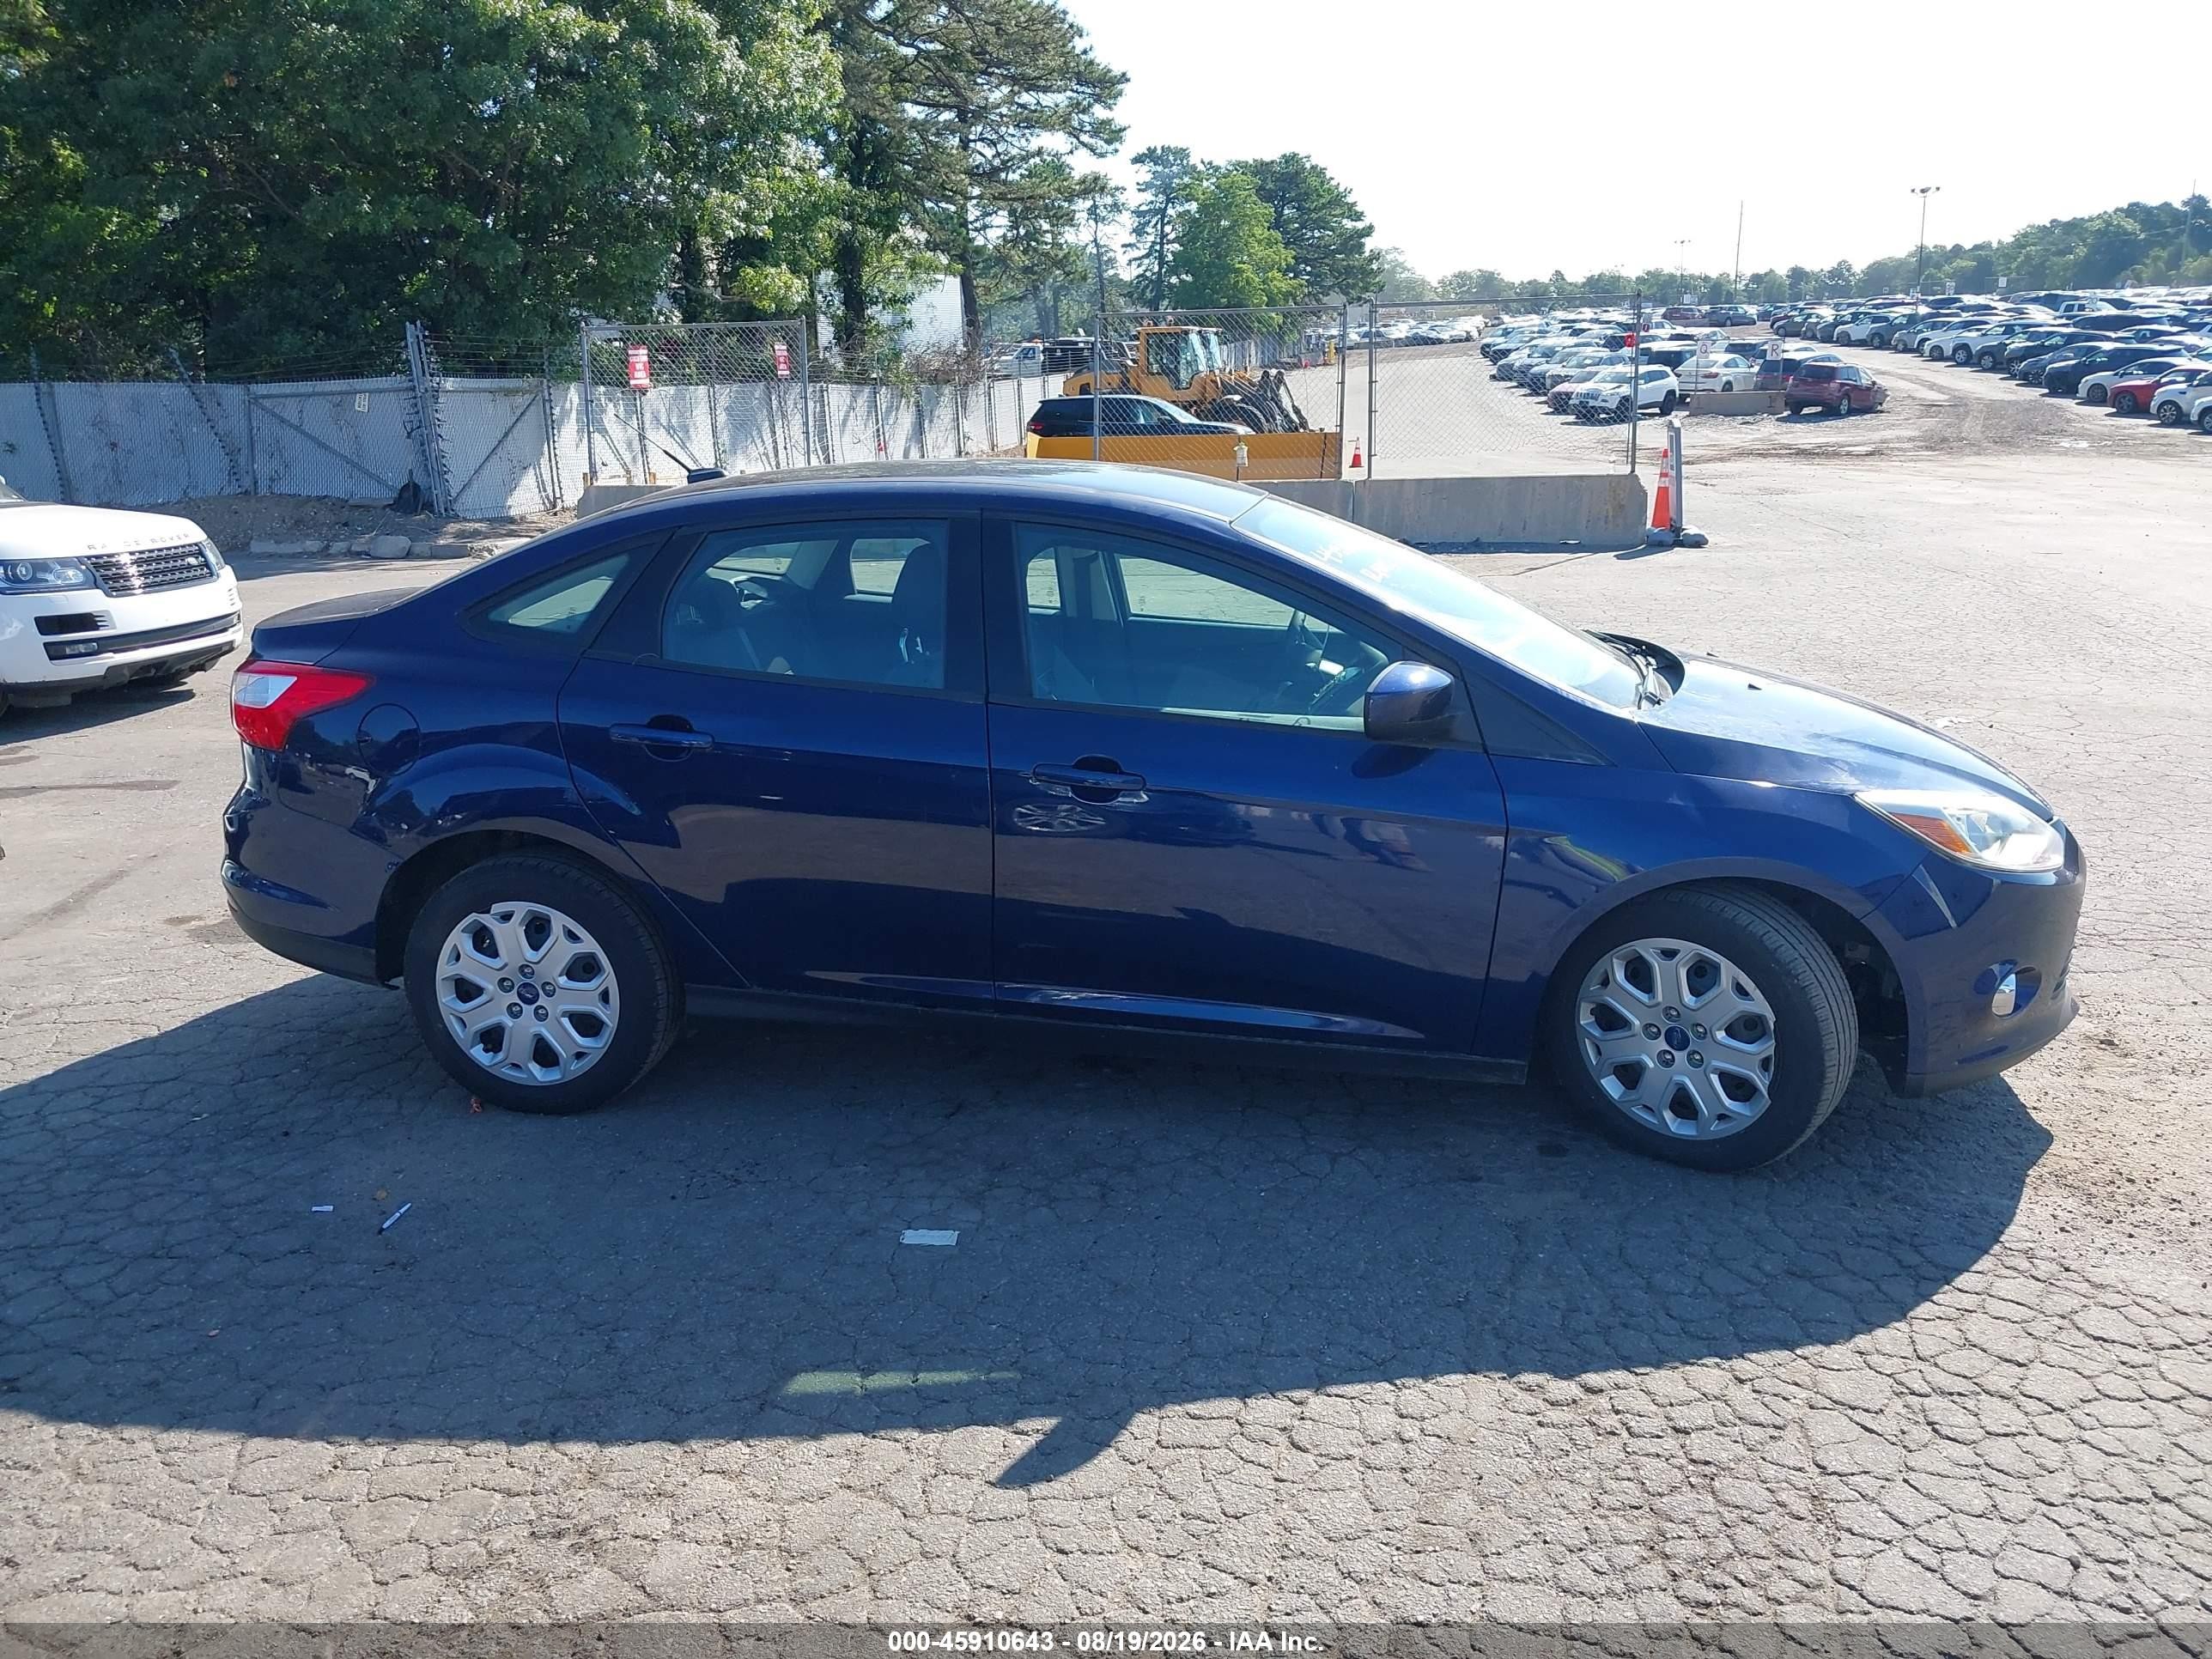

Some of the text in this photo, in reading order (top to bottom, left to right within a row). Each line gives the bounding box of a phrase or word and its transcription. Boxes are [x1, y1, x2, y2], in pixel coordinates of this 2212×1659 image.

[1700, 343, 1709, 356] Q
[1771, 343, 1779, 357] R
[87, 539, 142, 550] RAGE
